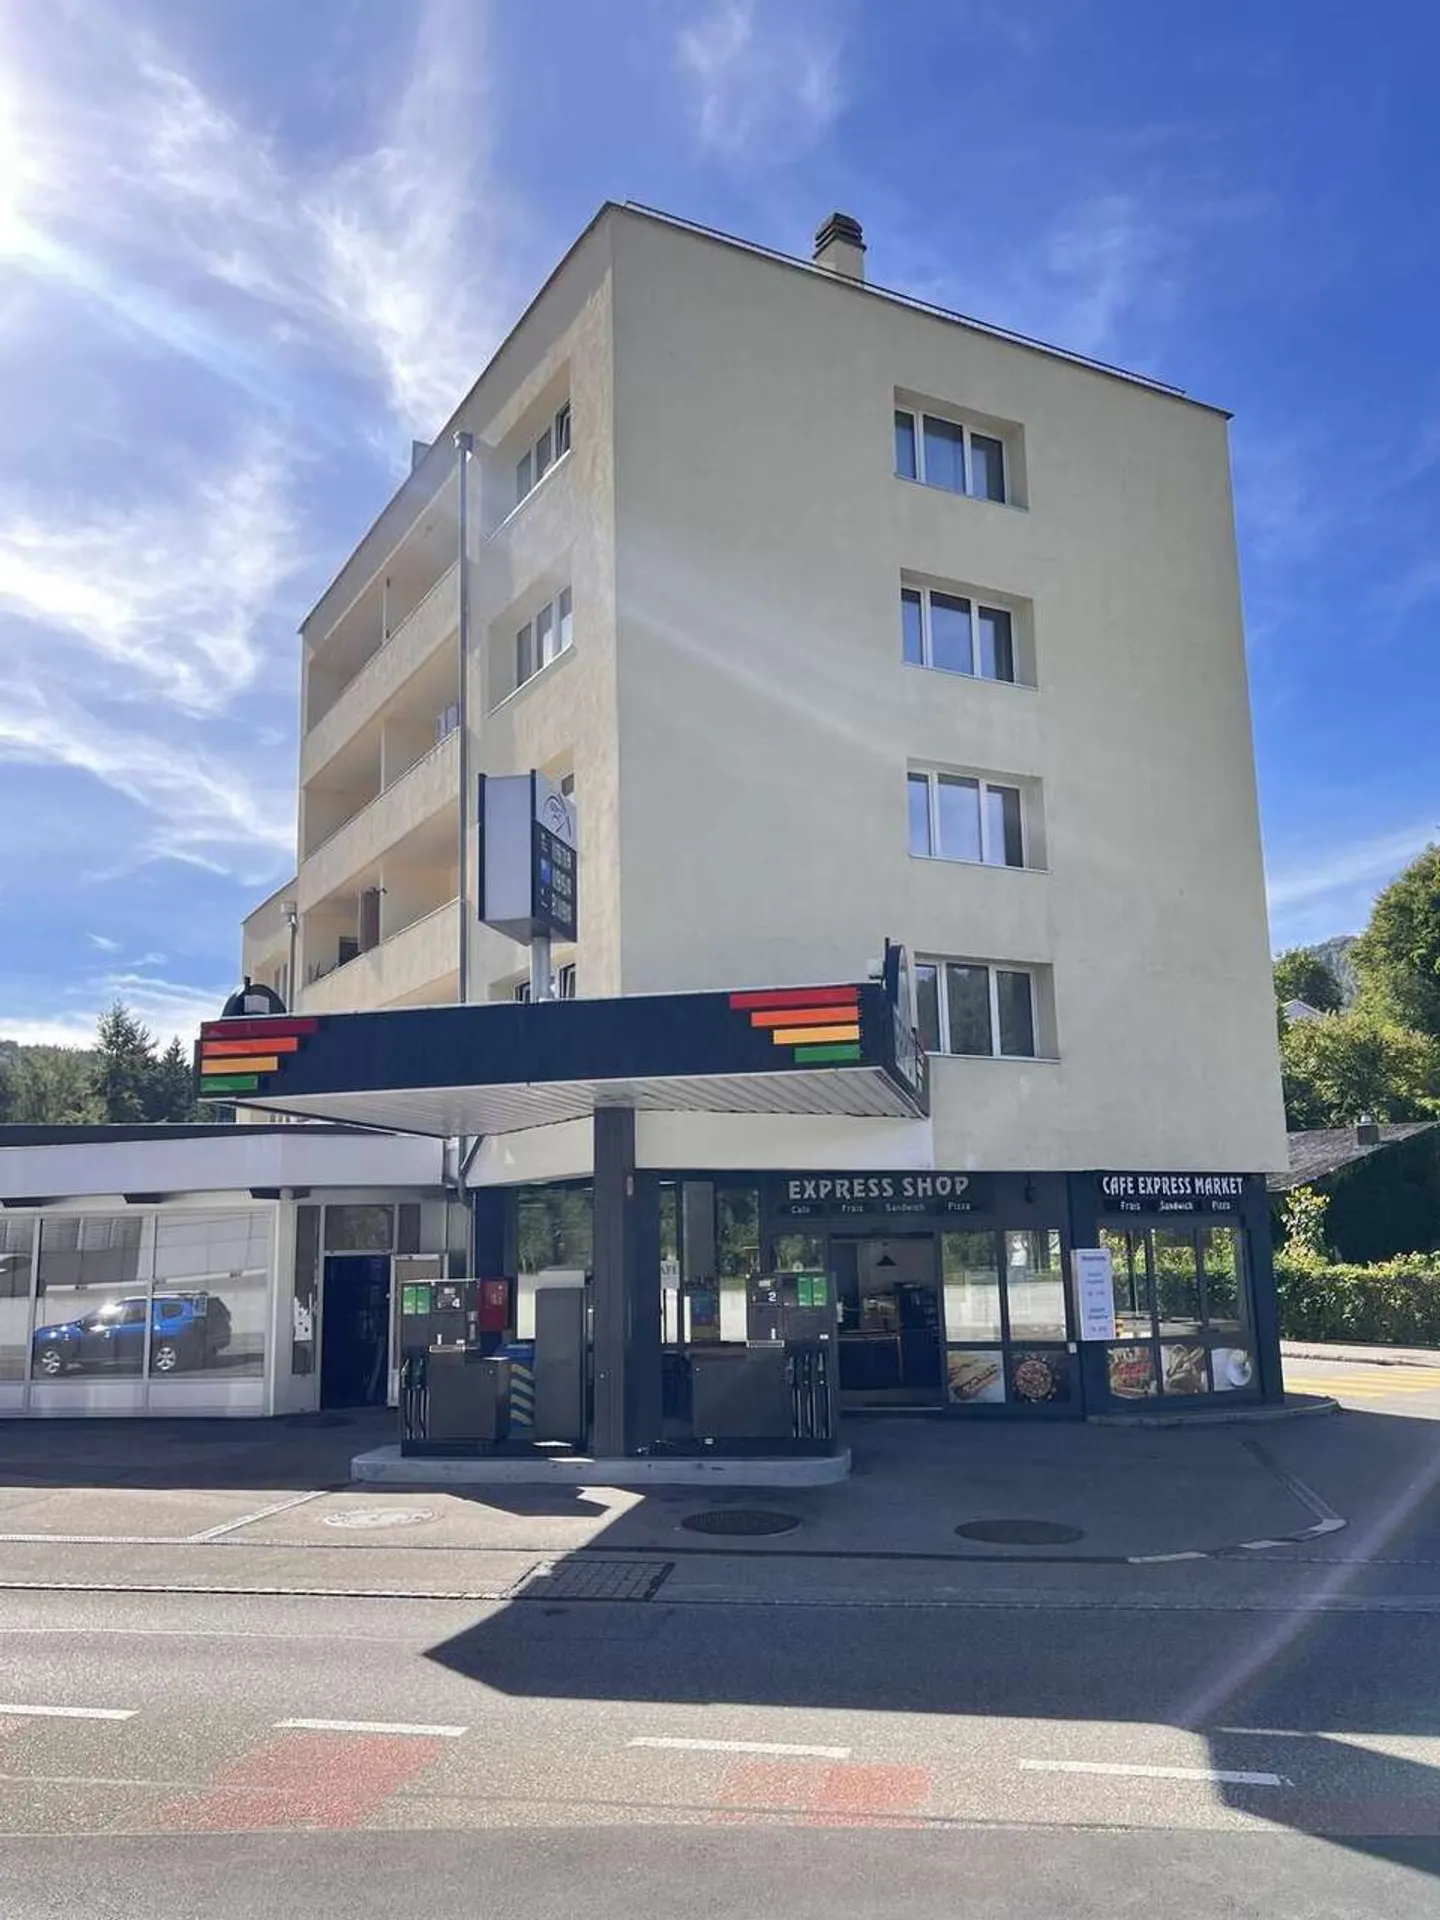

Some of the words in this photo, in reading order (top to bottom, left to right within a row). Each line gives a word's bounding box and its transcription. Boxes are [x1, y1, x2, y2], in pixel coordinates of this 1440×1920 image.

[788, 1178, 894, 1200] EXPRESS
[903, 1176, 969, 1197] SHOP
[1102, 1176, 1134, 1195] CAFE
[1138, 1176, 1191, 1195] EXPRESS
[1194, 1177, 1243, 1195] MARKET
[885, 1202, 925, 1212] Sandwich
[947, 1201, 971, 1212] Pizza
[1120, 1201, 1141, 1211] Frais
[1158, 1200, 1193, 1211] Sandwich
[1212, 1201, 1231, 1210] Pizza
[768, 1291, 777, 1302] 2
